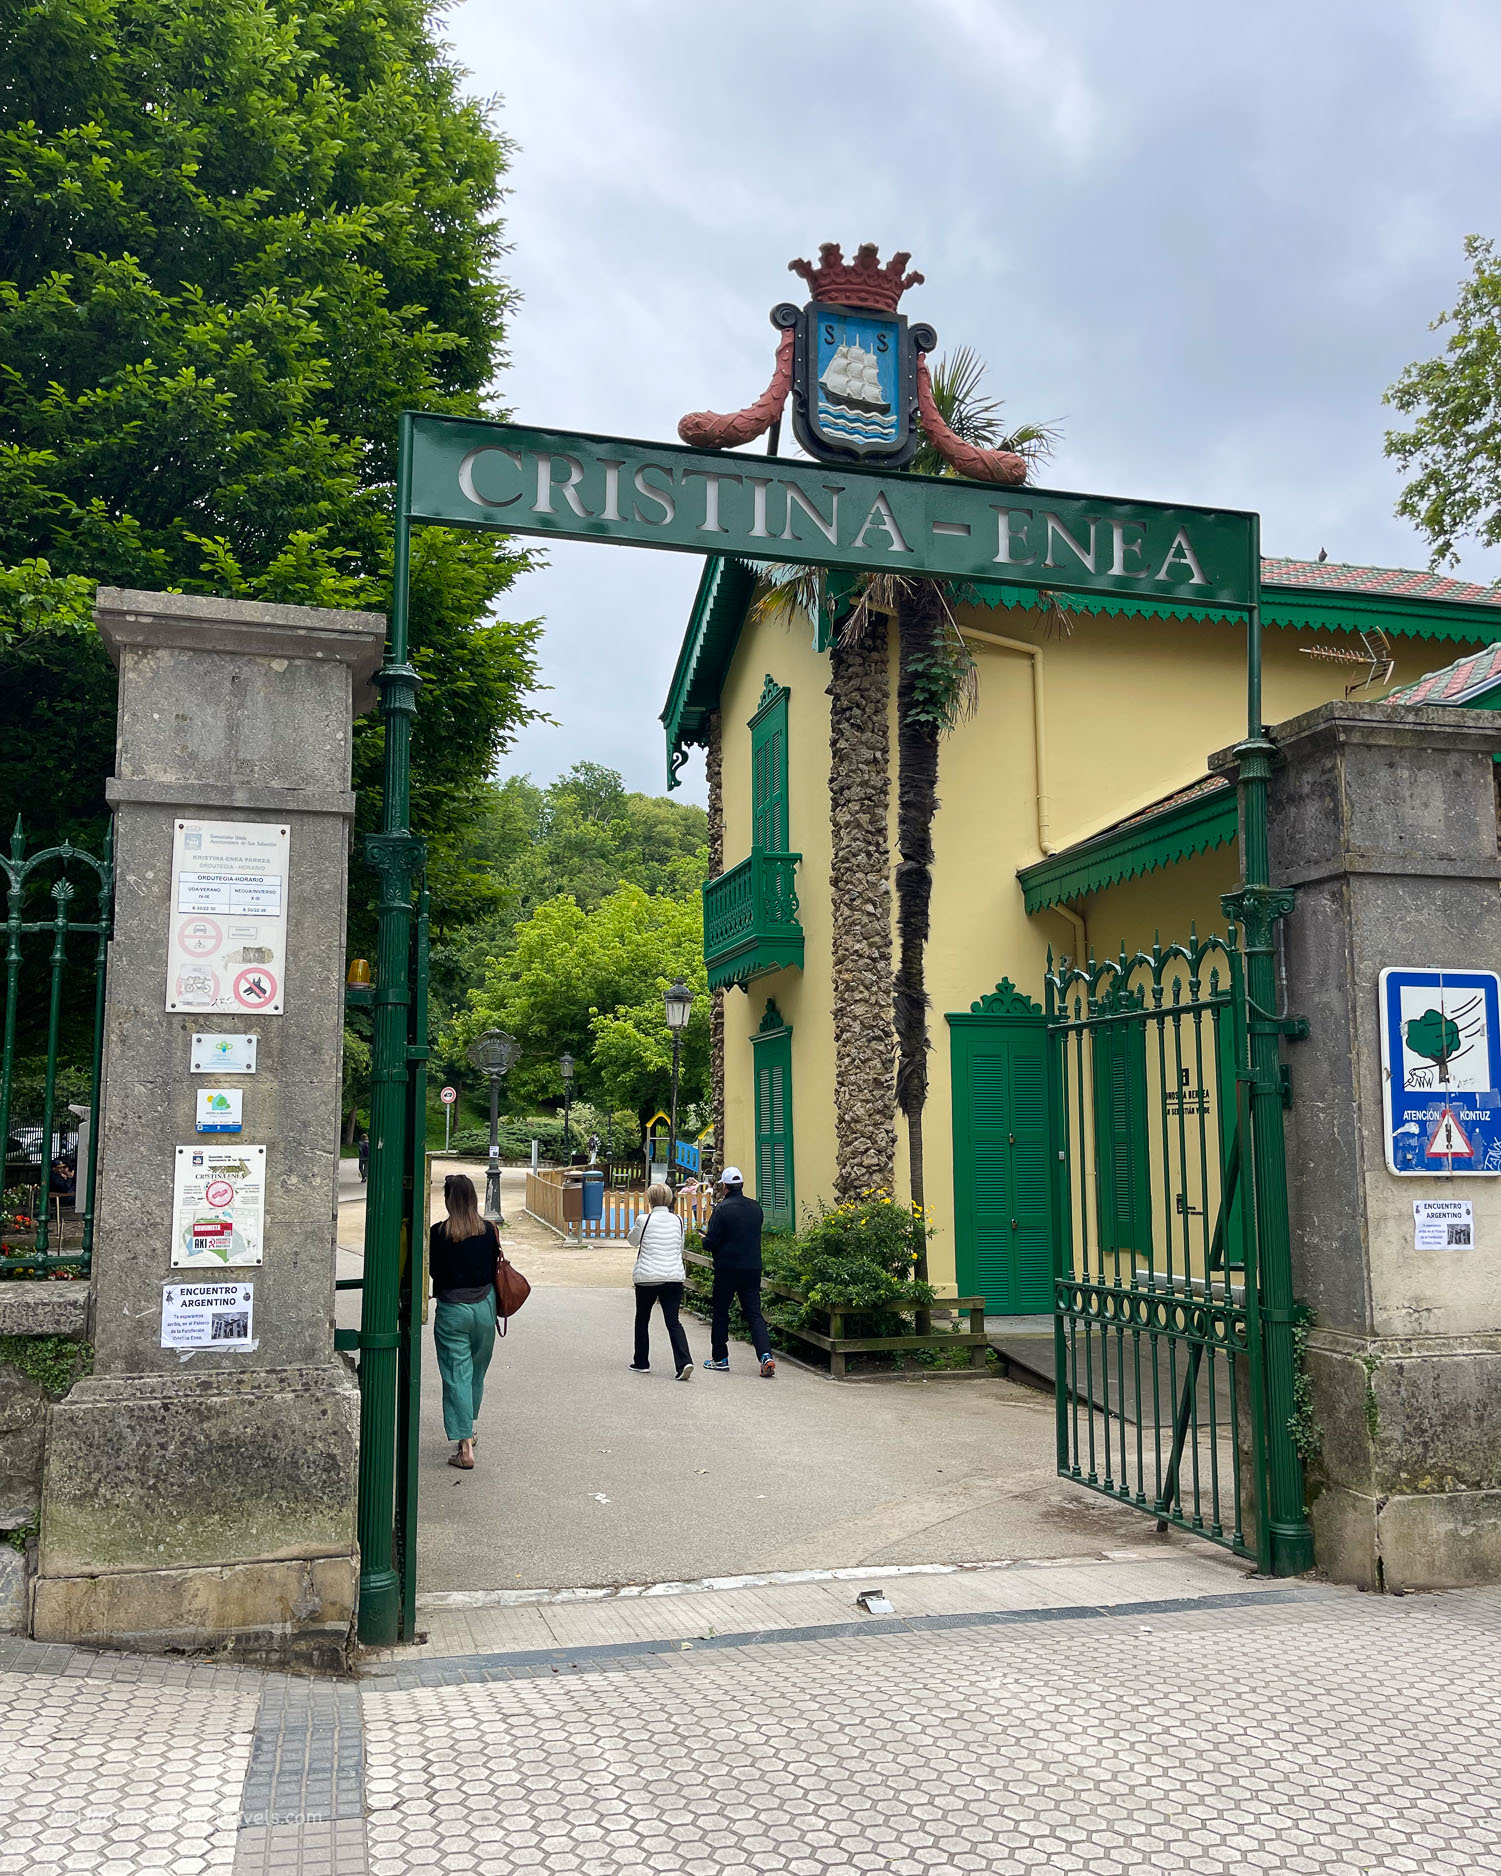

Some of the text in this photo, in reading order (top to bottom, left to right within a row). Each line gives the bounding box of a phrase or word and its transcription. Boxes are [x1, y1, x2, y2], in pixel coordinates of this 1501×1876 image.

[824, 324, 889, 352] S S
[1403, 1108, 1440, 1120] ATENCIÓN
[1460, 1111, 1490, 1120] KONTUZ
[194, 1239, 207, 1248] AKI
[180, 1286, 238, 1296] ENCUENTRO
[181, 1298, 236, 1307] ARGENTINO
